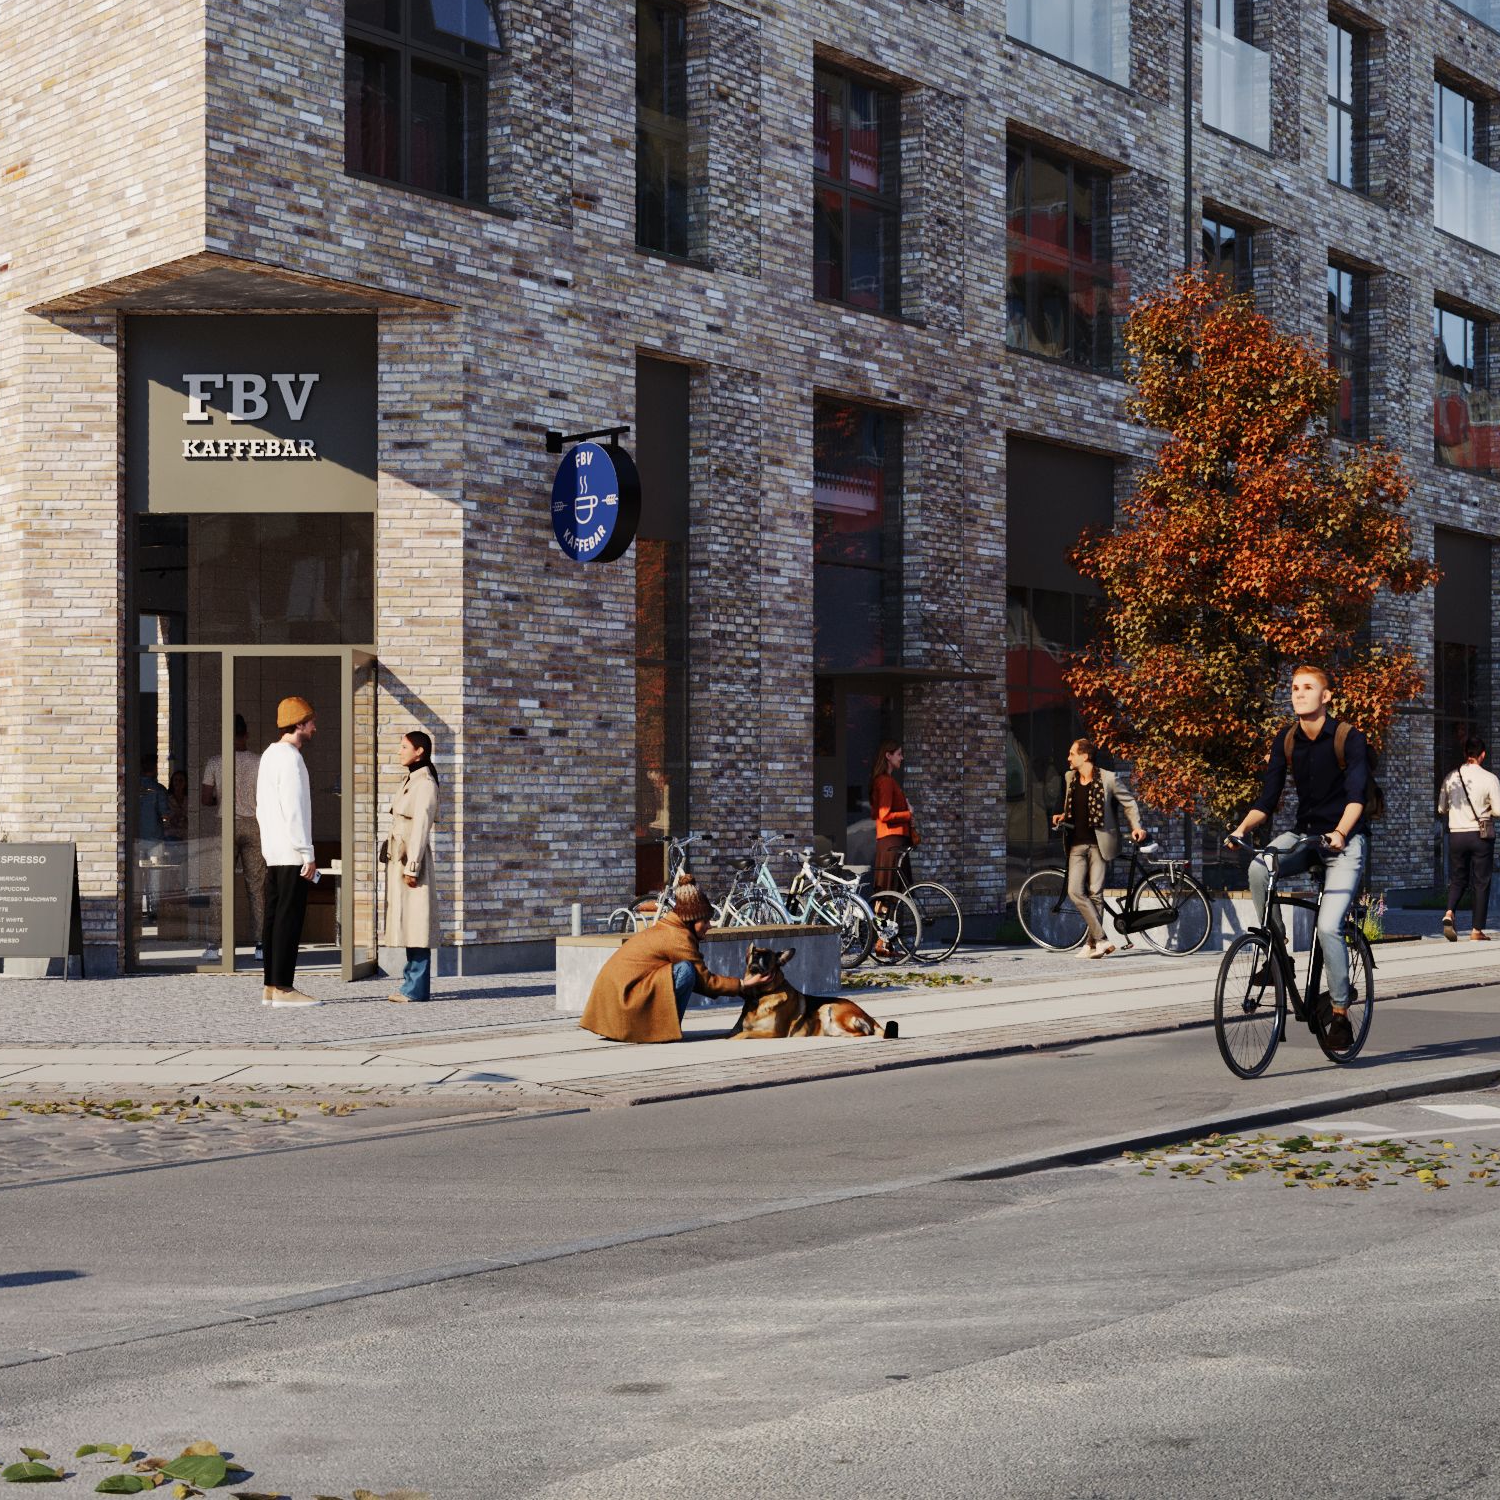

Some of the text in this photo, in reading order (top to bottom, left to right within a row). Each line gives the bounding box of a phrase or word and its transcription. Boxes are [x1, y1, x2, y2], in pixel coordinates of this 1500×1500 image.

[182, 373, 319, 420] FBV
[182, 439, 316, 457] KAFFEBAR
[575, 451, 593, 468] FBV
[563, 524, 607, 552] KAFFEBAR
